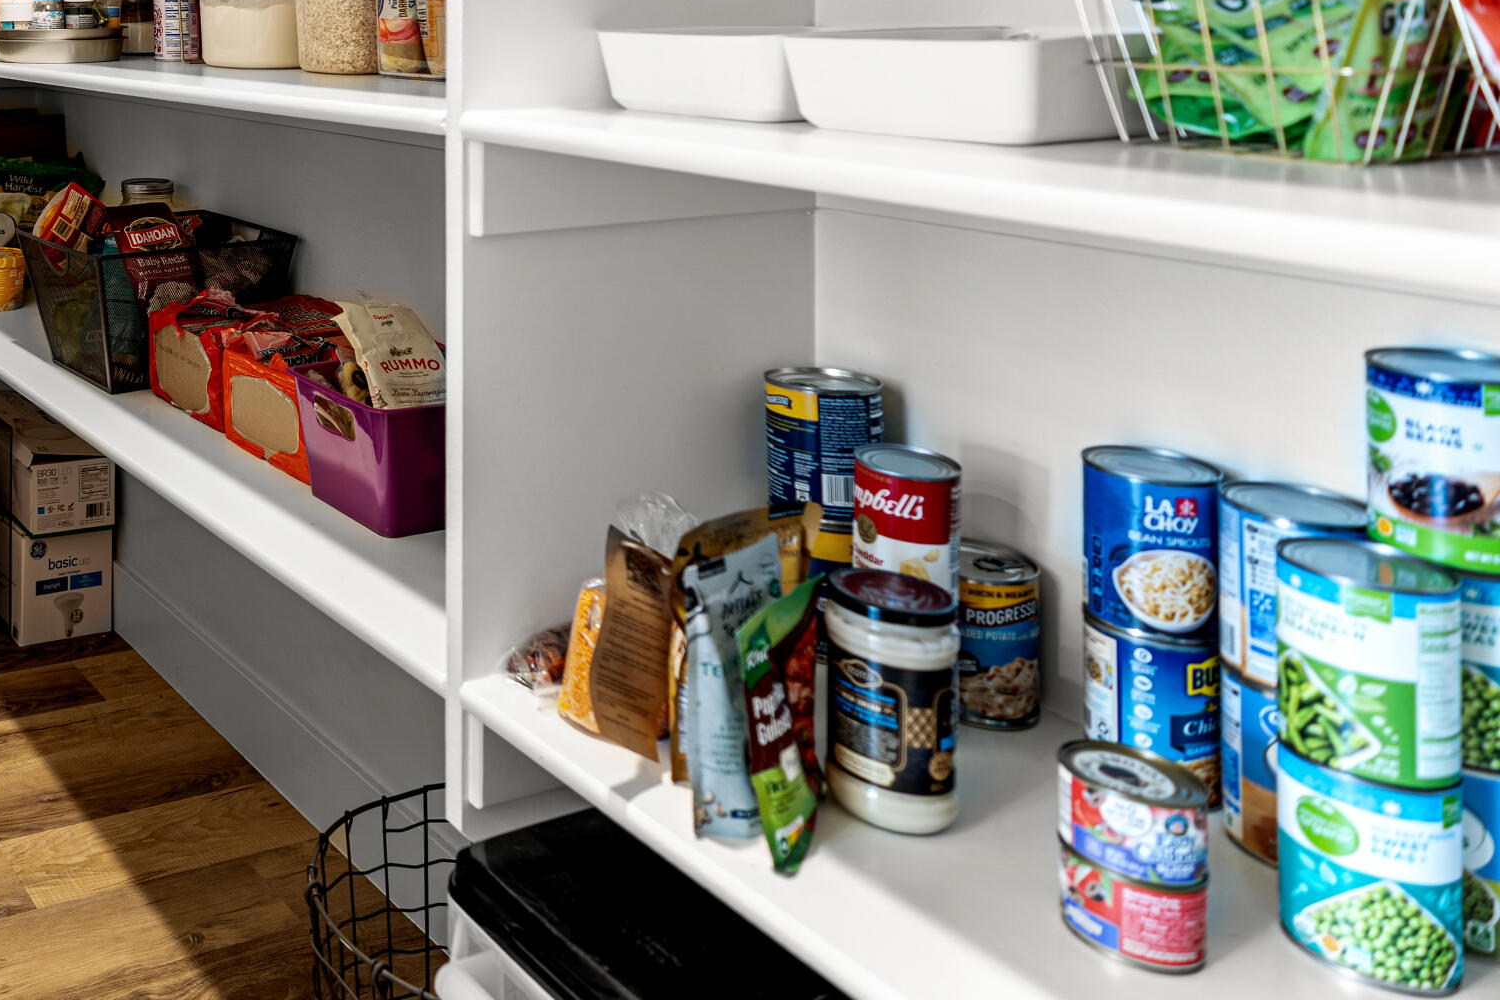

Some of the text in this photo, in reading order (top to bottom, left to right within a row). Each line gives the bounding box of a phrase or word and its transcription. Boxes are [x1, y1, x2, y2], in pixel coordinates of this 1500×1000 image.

[5, 182, 44, 194] Harvest
[9, 174, 34, 185] Wild
[131, 227, 176, 246] IDAHOAN
[137, 256, 160, 268] Baby
[380, 358, 441, 374] RUMMO
[1406, 430, 1463, 450] BEANS
[37, 468, 57, 477] BR30
[854, 488, 925, 521] mpbell's
[1144, 495, 1174, 516] LA
[1143, 514, 1199, 535] CHOY
[1128, 529, 1211, 548] BEAN SPROUTS
[48, 556, 91, 570] basic LED
[966, 600, 1037, 626] PROGRESSO
[985, 630, 1018, 642] POTATO
[1370, 834, 1429, 852] SWEET
[1371, 846, 1416, 864] PEAS
